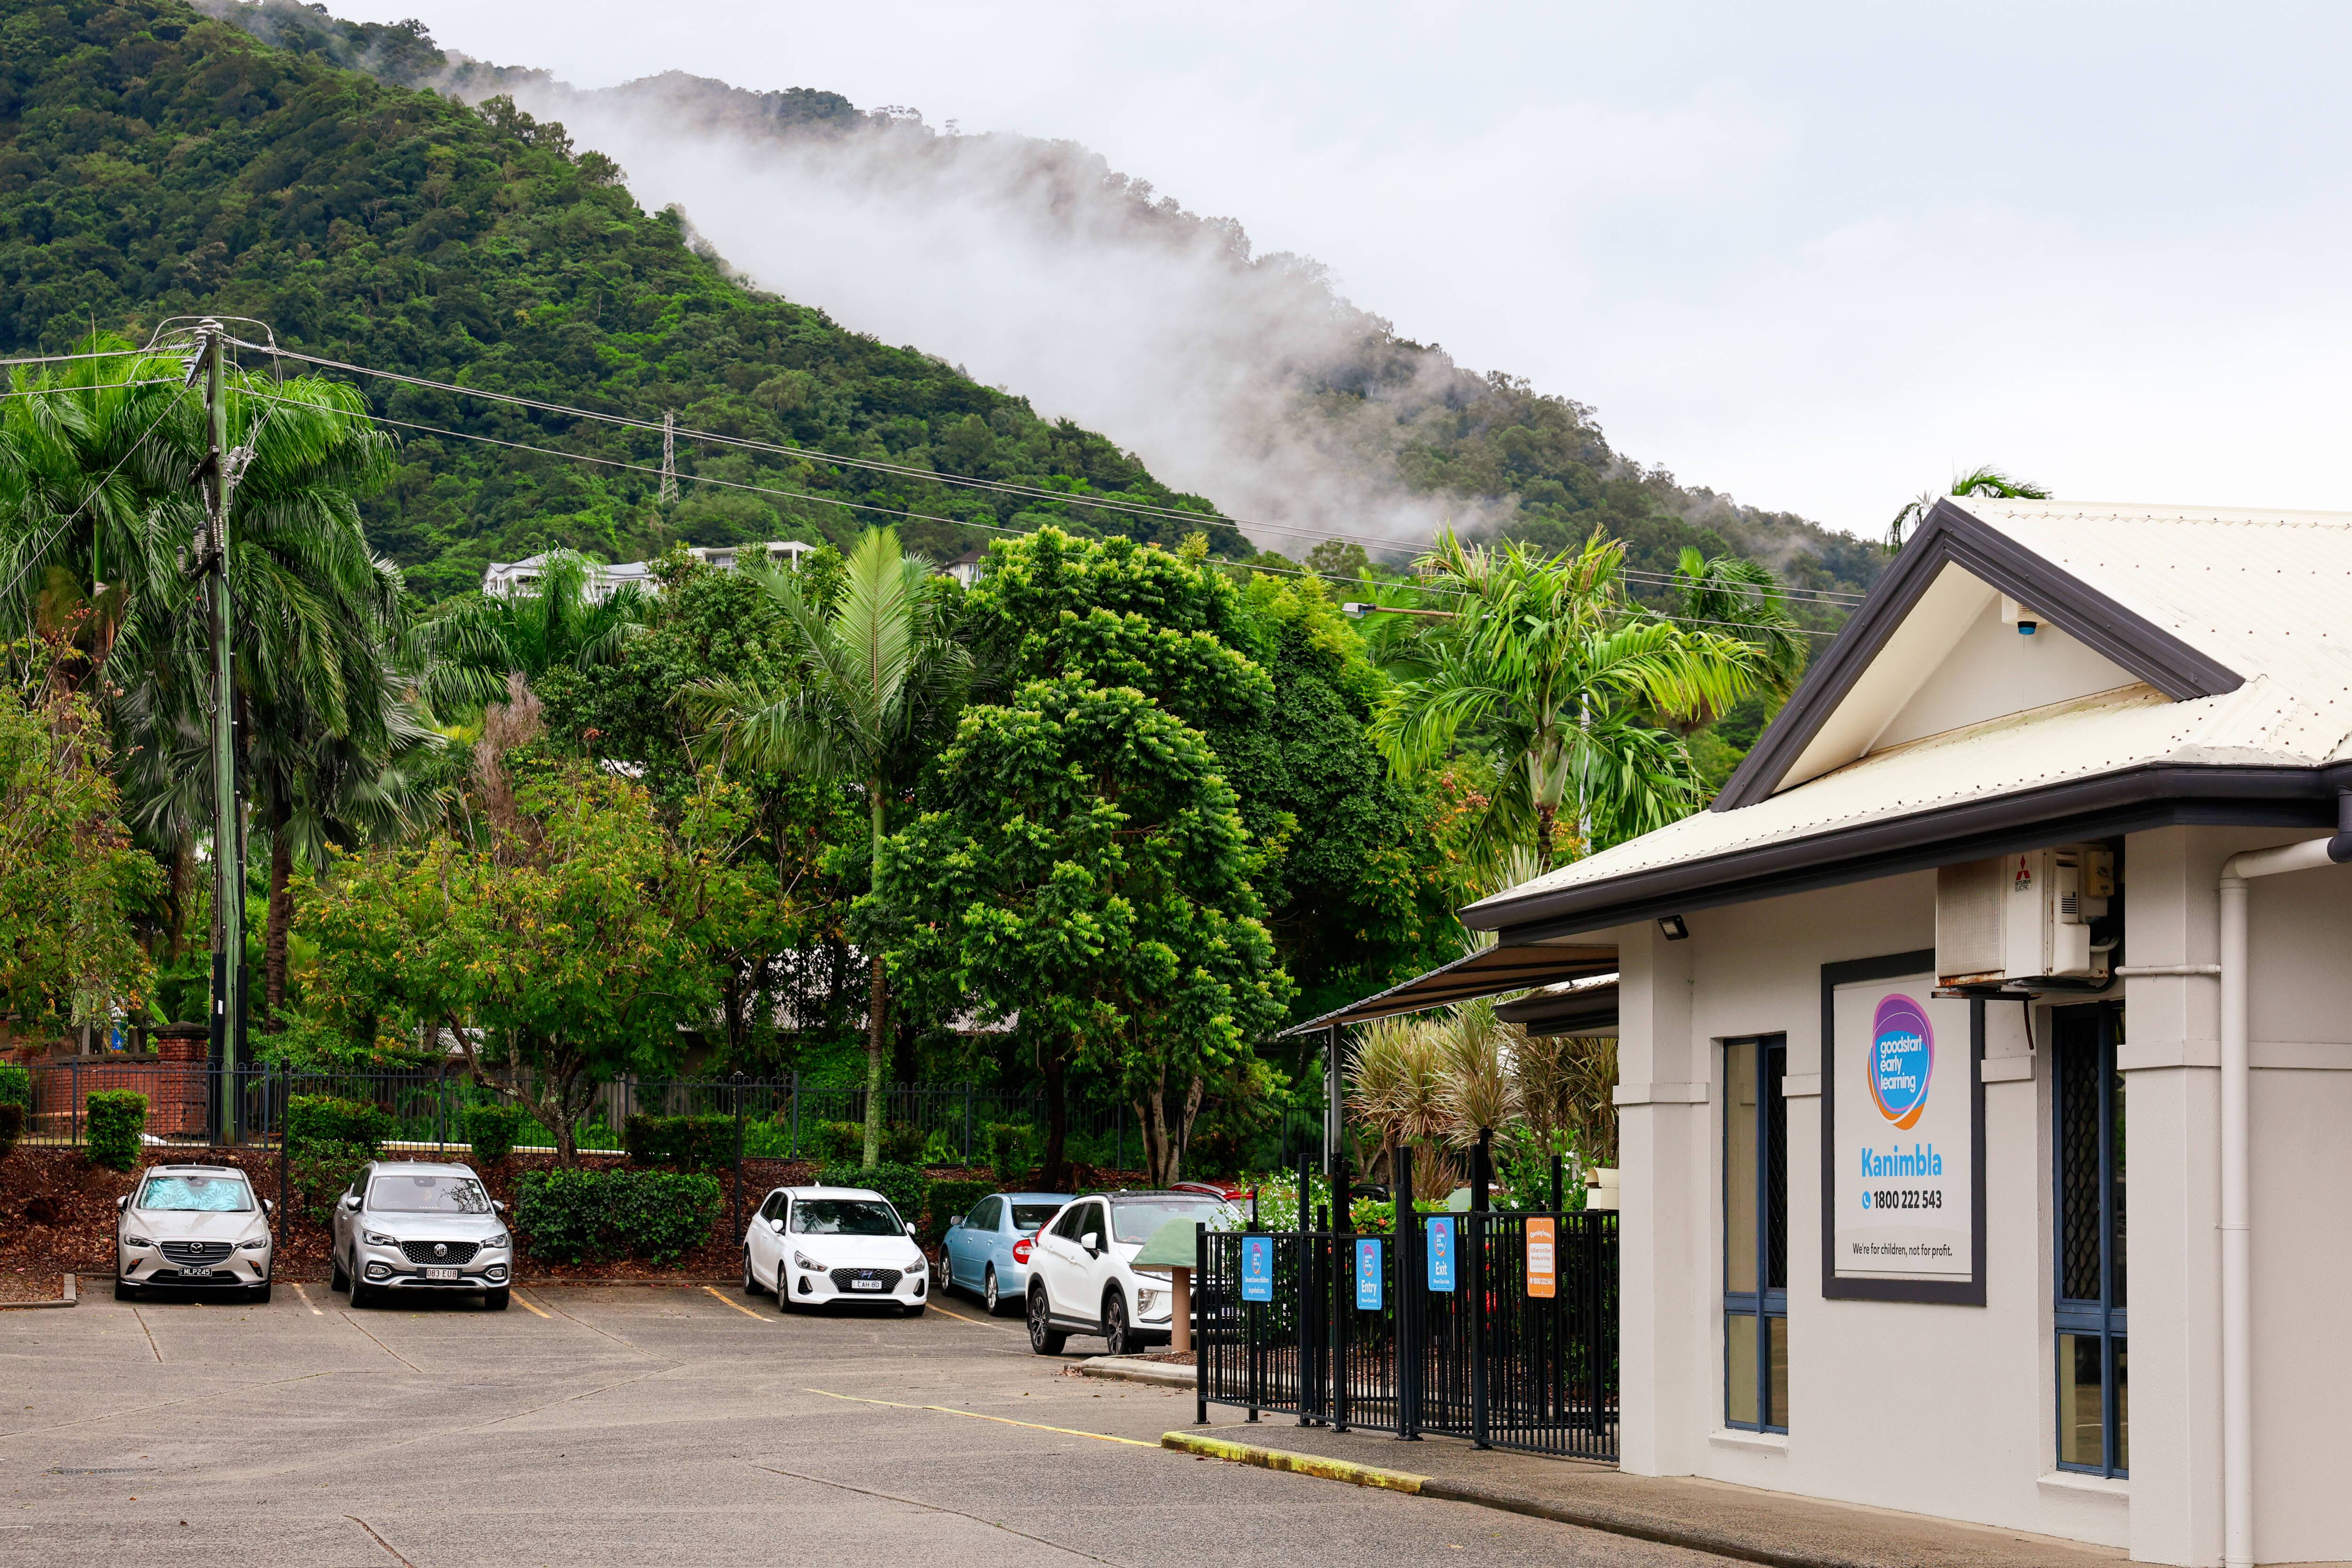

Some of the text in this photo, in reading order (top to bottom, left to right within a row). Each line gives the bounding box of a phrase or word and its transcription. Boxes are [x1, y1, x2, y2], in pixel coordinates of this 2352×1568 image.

[1880, 1035, 1922, 1059] goodstart
[1880, 1055, 1902, 1075] early
[1881, 1072, 1915, 1093] learning
[1862, 1144, 1942, 1177] Kanimbla
[1874, 1190, 1942, 1209] 1800 222 543
[1530, 1229, 1542, 1238] Opening
[1853, 1243, 1952, 1258] We're for children, not for profit.
[1435, 1261, 1447, 1276] Exit
[1361, 1280, 1377, 1297] Entry
